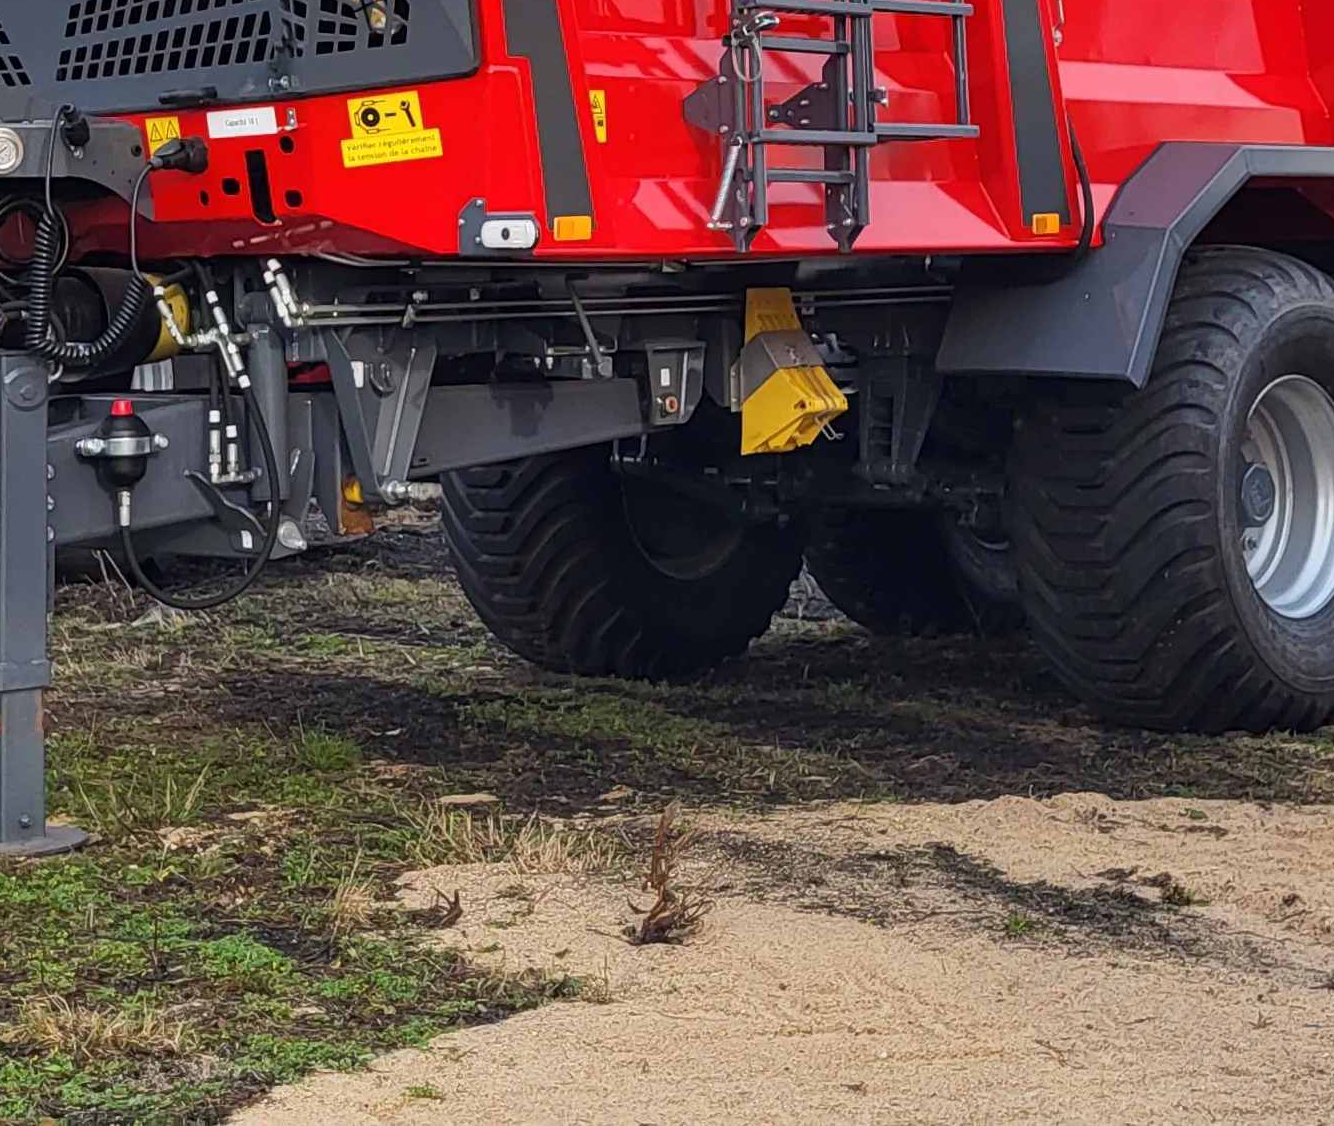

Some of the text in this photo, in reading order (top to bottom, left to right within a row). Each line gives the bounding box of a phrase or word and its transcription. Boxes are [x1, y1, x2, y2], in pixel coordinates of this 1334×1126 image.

[357, 152, 387, 161] tension
[389, 149, 399, 157] de
[401, 147, 409, 155] la
